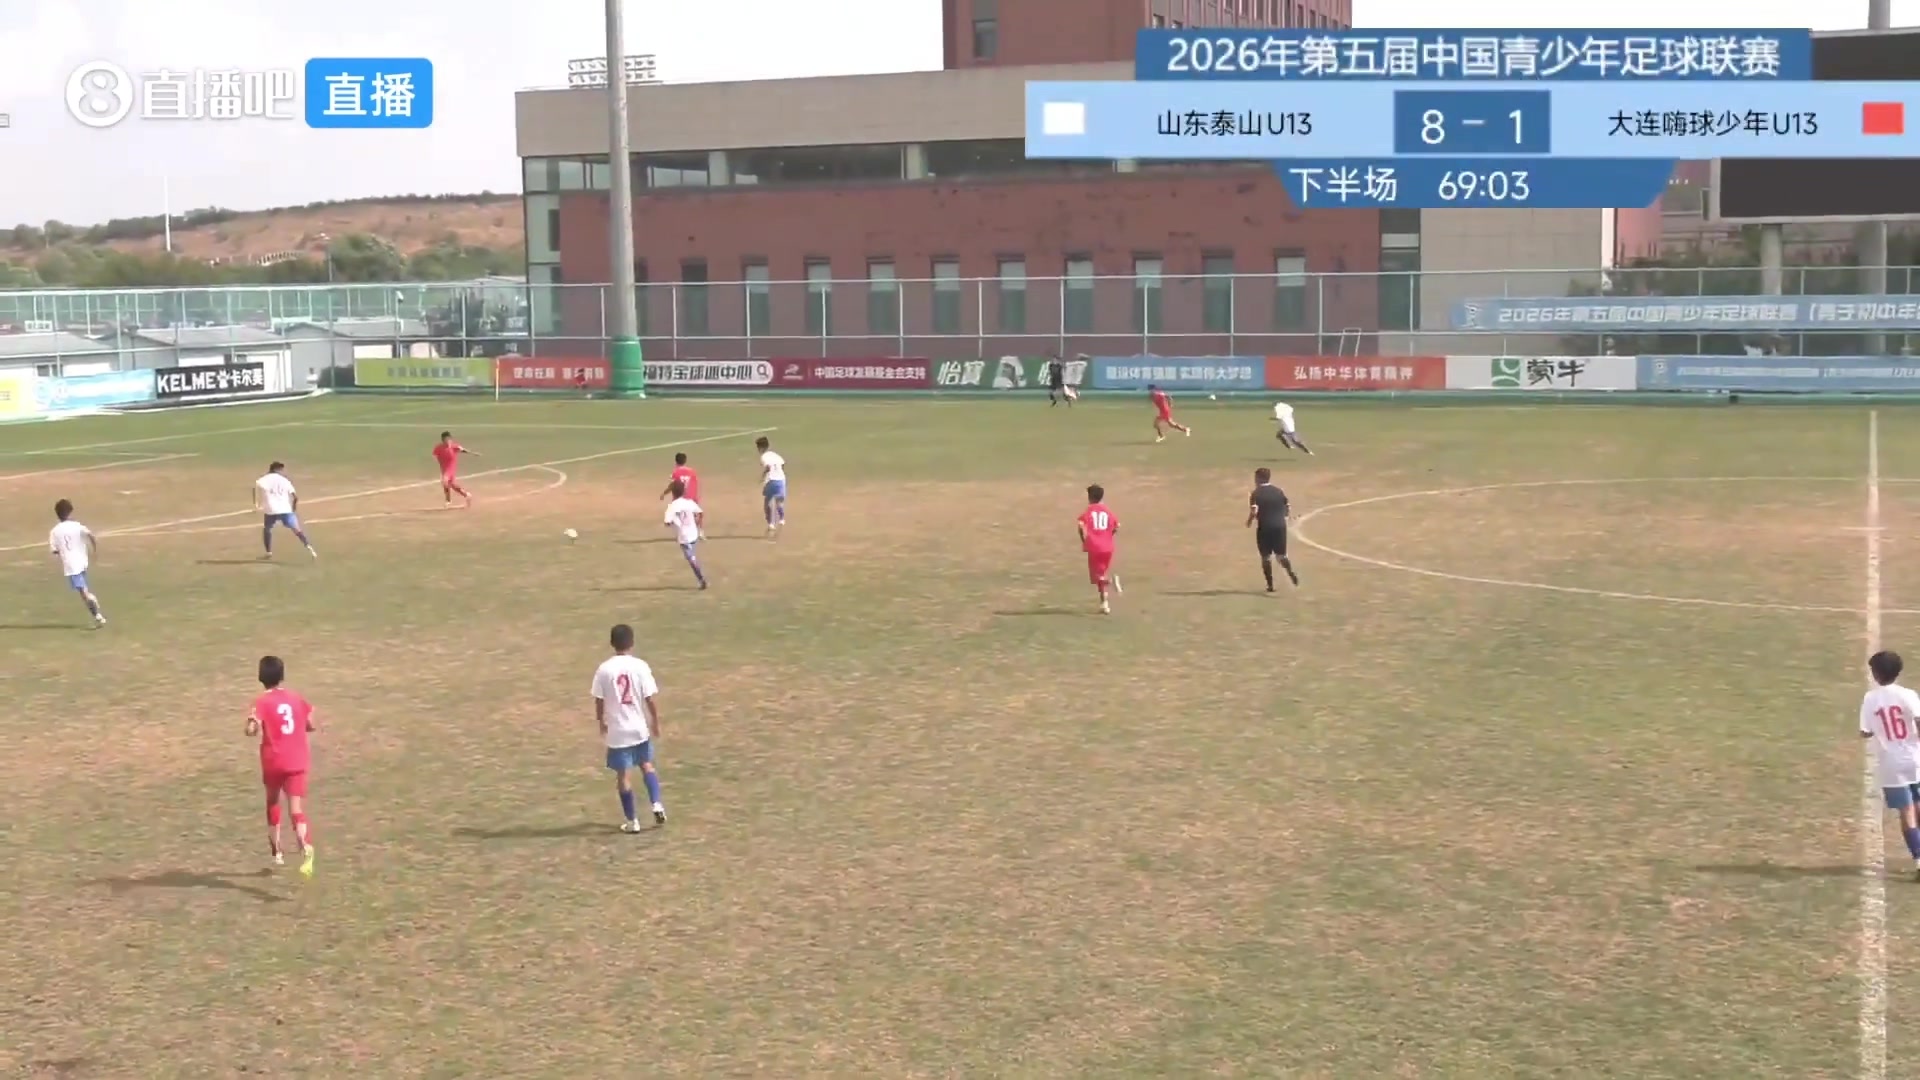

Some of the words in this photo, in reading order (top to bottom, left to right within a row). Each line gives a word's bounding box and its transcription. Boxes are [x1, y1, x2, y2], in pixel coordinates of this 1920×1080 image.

[157, 371, 217, 394] KELME
[1293, 366, 1414, 381] 弘扬中华体育精神
[1527, 359, 1585, 388] 蒙牛
[1091, 511, 1108, 531] 10
[616, 673, 634, 705] 2
[277, 703, 296, 735] 3
[1874, 705, 1908, 742] 16
